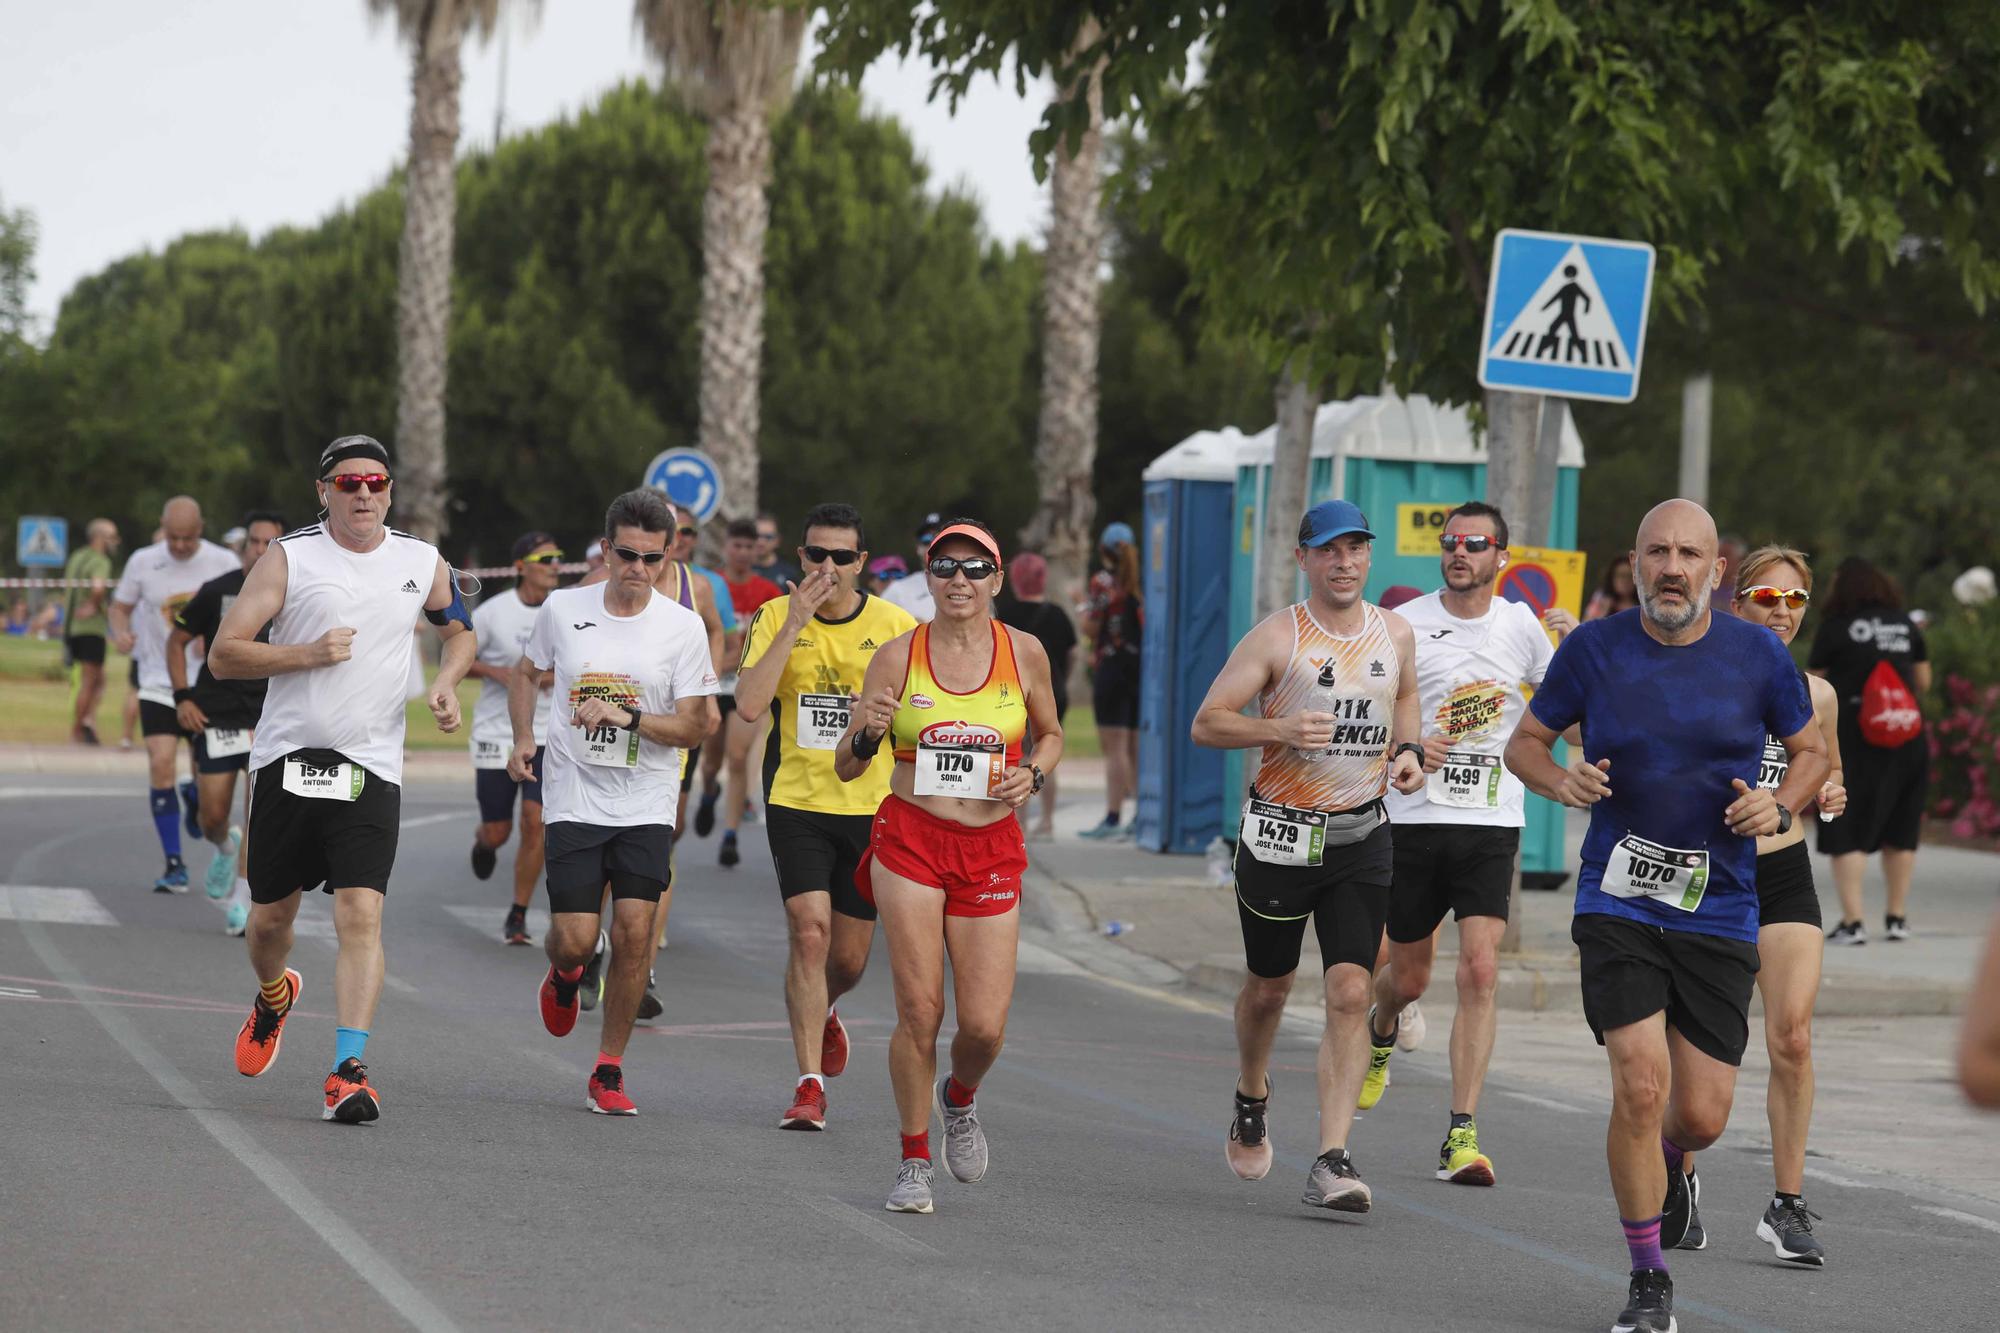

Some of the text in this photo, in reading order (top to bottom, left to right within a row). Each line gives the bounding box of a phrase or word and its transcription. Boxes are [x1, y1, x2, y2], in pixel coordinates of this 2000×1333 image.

[1413, 511, 1445, 528] BO
[579, 687, 610, 695] MEDIO
[578, 693, 628, 704] MATÓN
[911, 698, 933, 706] Serrano
[1452, 695, 1481, 708] MEDIO
[1487, 706, 1498, 716] DE
[812, 710, 849, 729] 1329
[818, 730, 838, 738] JESUS
[929, 730, 997, 745] Serrano
[1329, 726, 1388, 745] ENCIA
[590, 745, 606, 753] JOSE
[1344, 749, 1362, 757] RUN
[936, 753, 973, 773] 1170
[992, 761, 1001, 774] BOX
[941, 774, 963, 782] SONIA
[1443, 767, 1480, 786] 1499
[1449, 787, 1470, 795] PEDRO
[1258, 819, 1298, 844] 1479
[1255, 840, 1295, 854] JOSE MARIA
[1627, 856, 1676, 883] 1070
[1630, 879, 1659, 891] DANIEL
